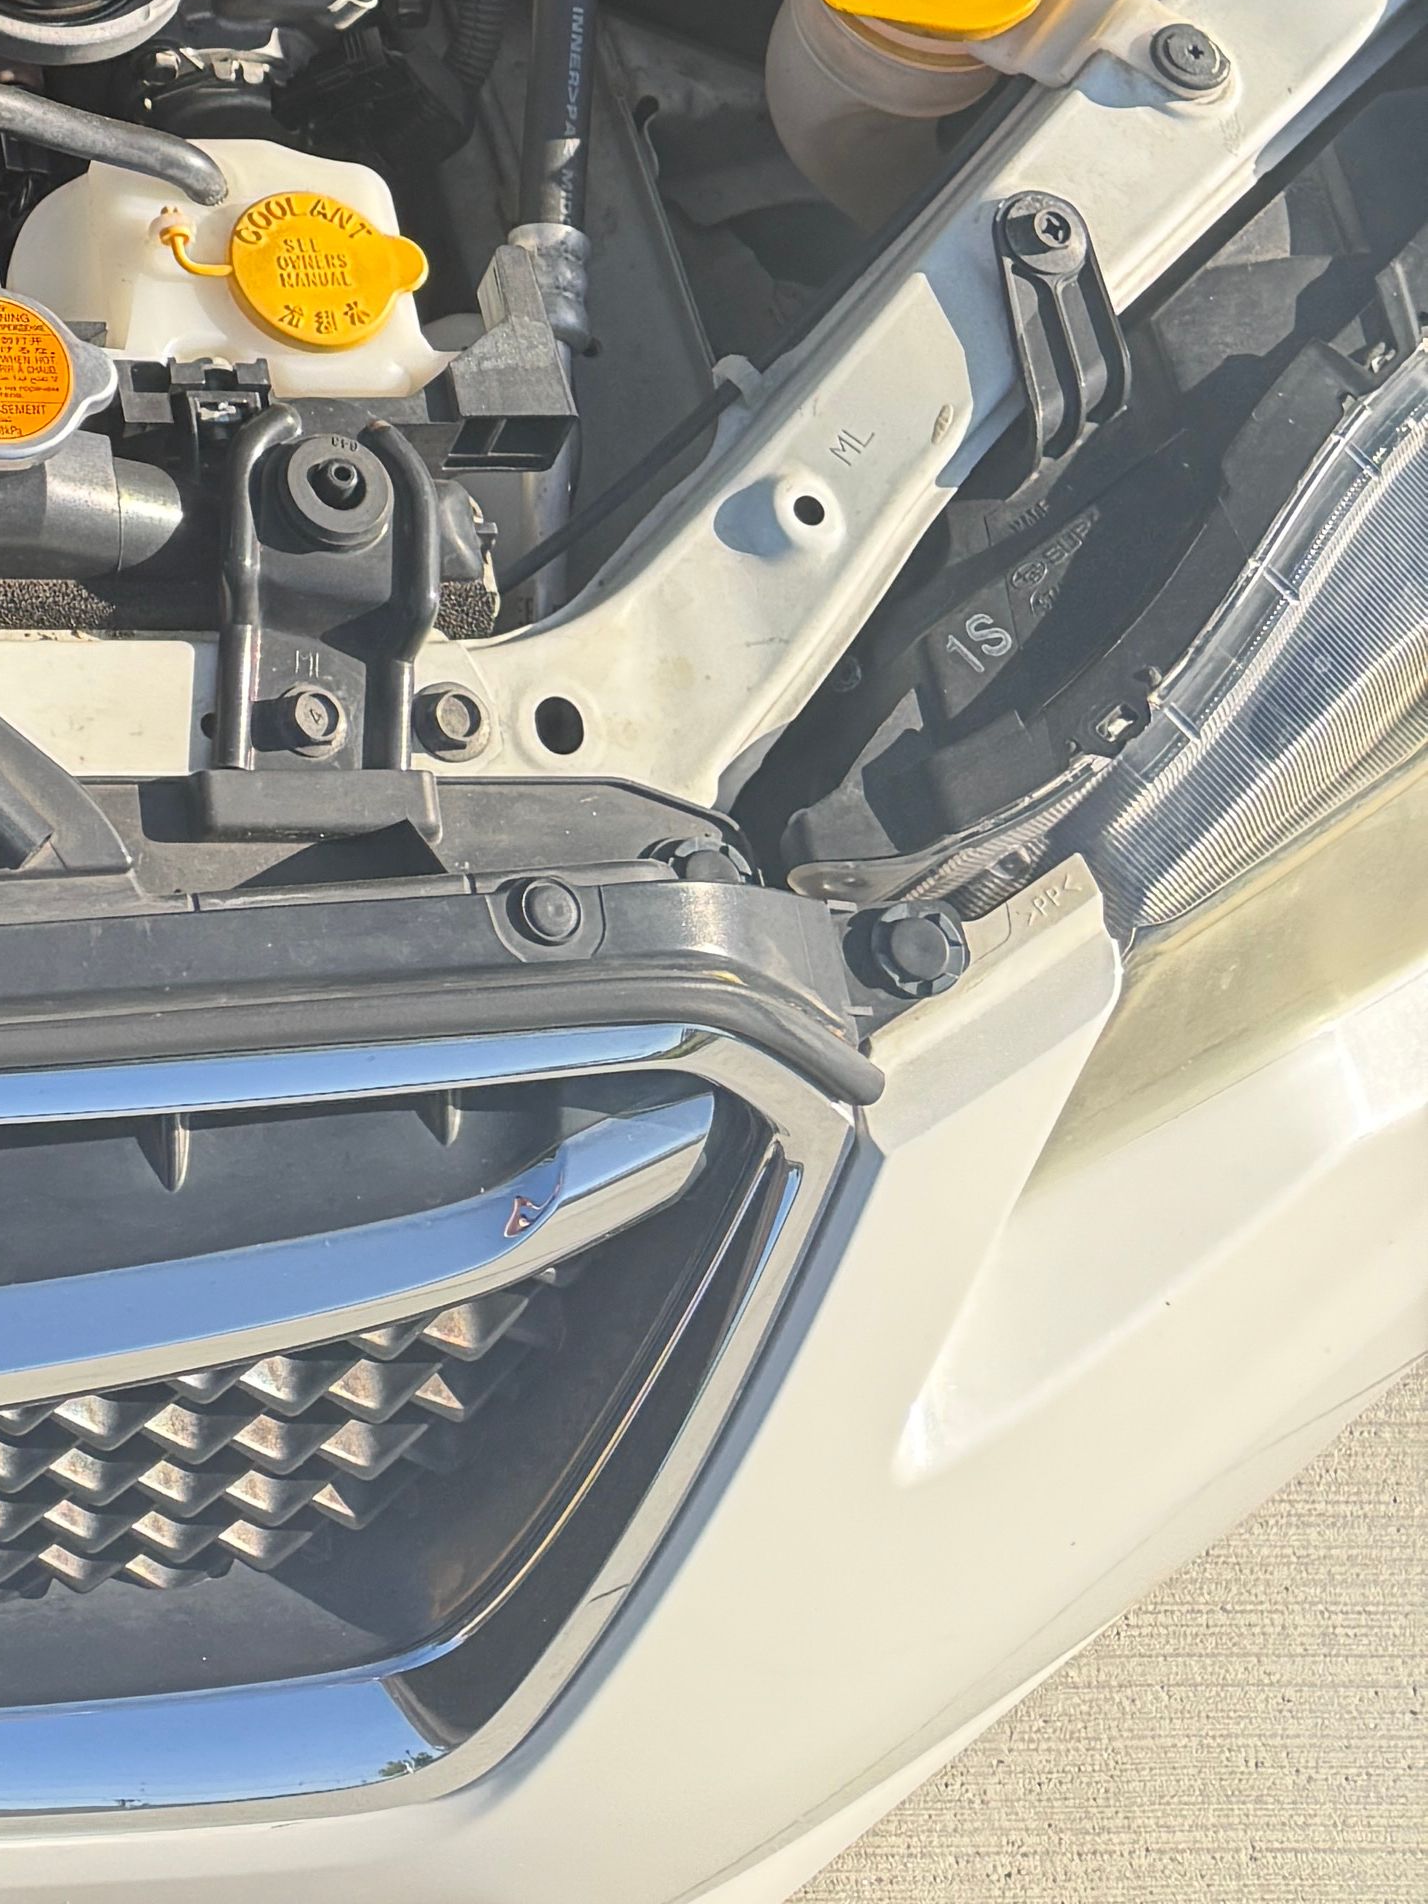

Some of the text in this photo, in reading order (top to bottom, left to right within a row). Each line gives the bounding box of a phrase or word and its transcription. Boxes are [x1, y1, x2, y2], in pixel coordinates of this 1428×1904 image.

[233, 196, 373, 245] COOLANT
[282, 237, 321, 254] SEE
[275, 253, 348, 272] OWNERS
[279, 271, 352, 289] MANUAL
[829, 428, 875, 467] ML
[945, 613, 1013, 674] 1S
